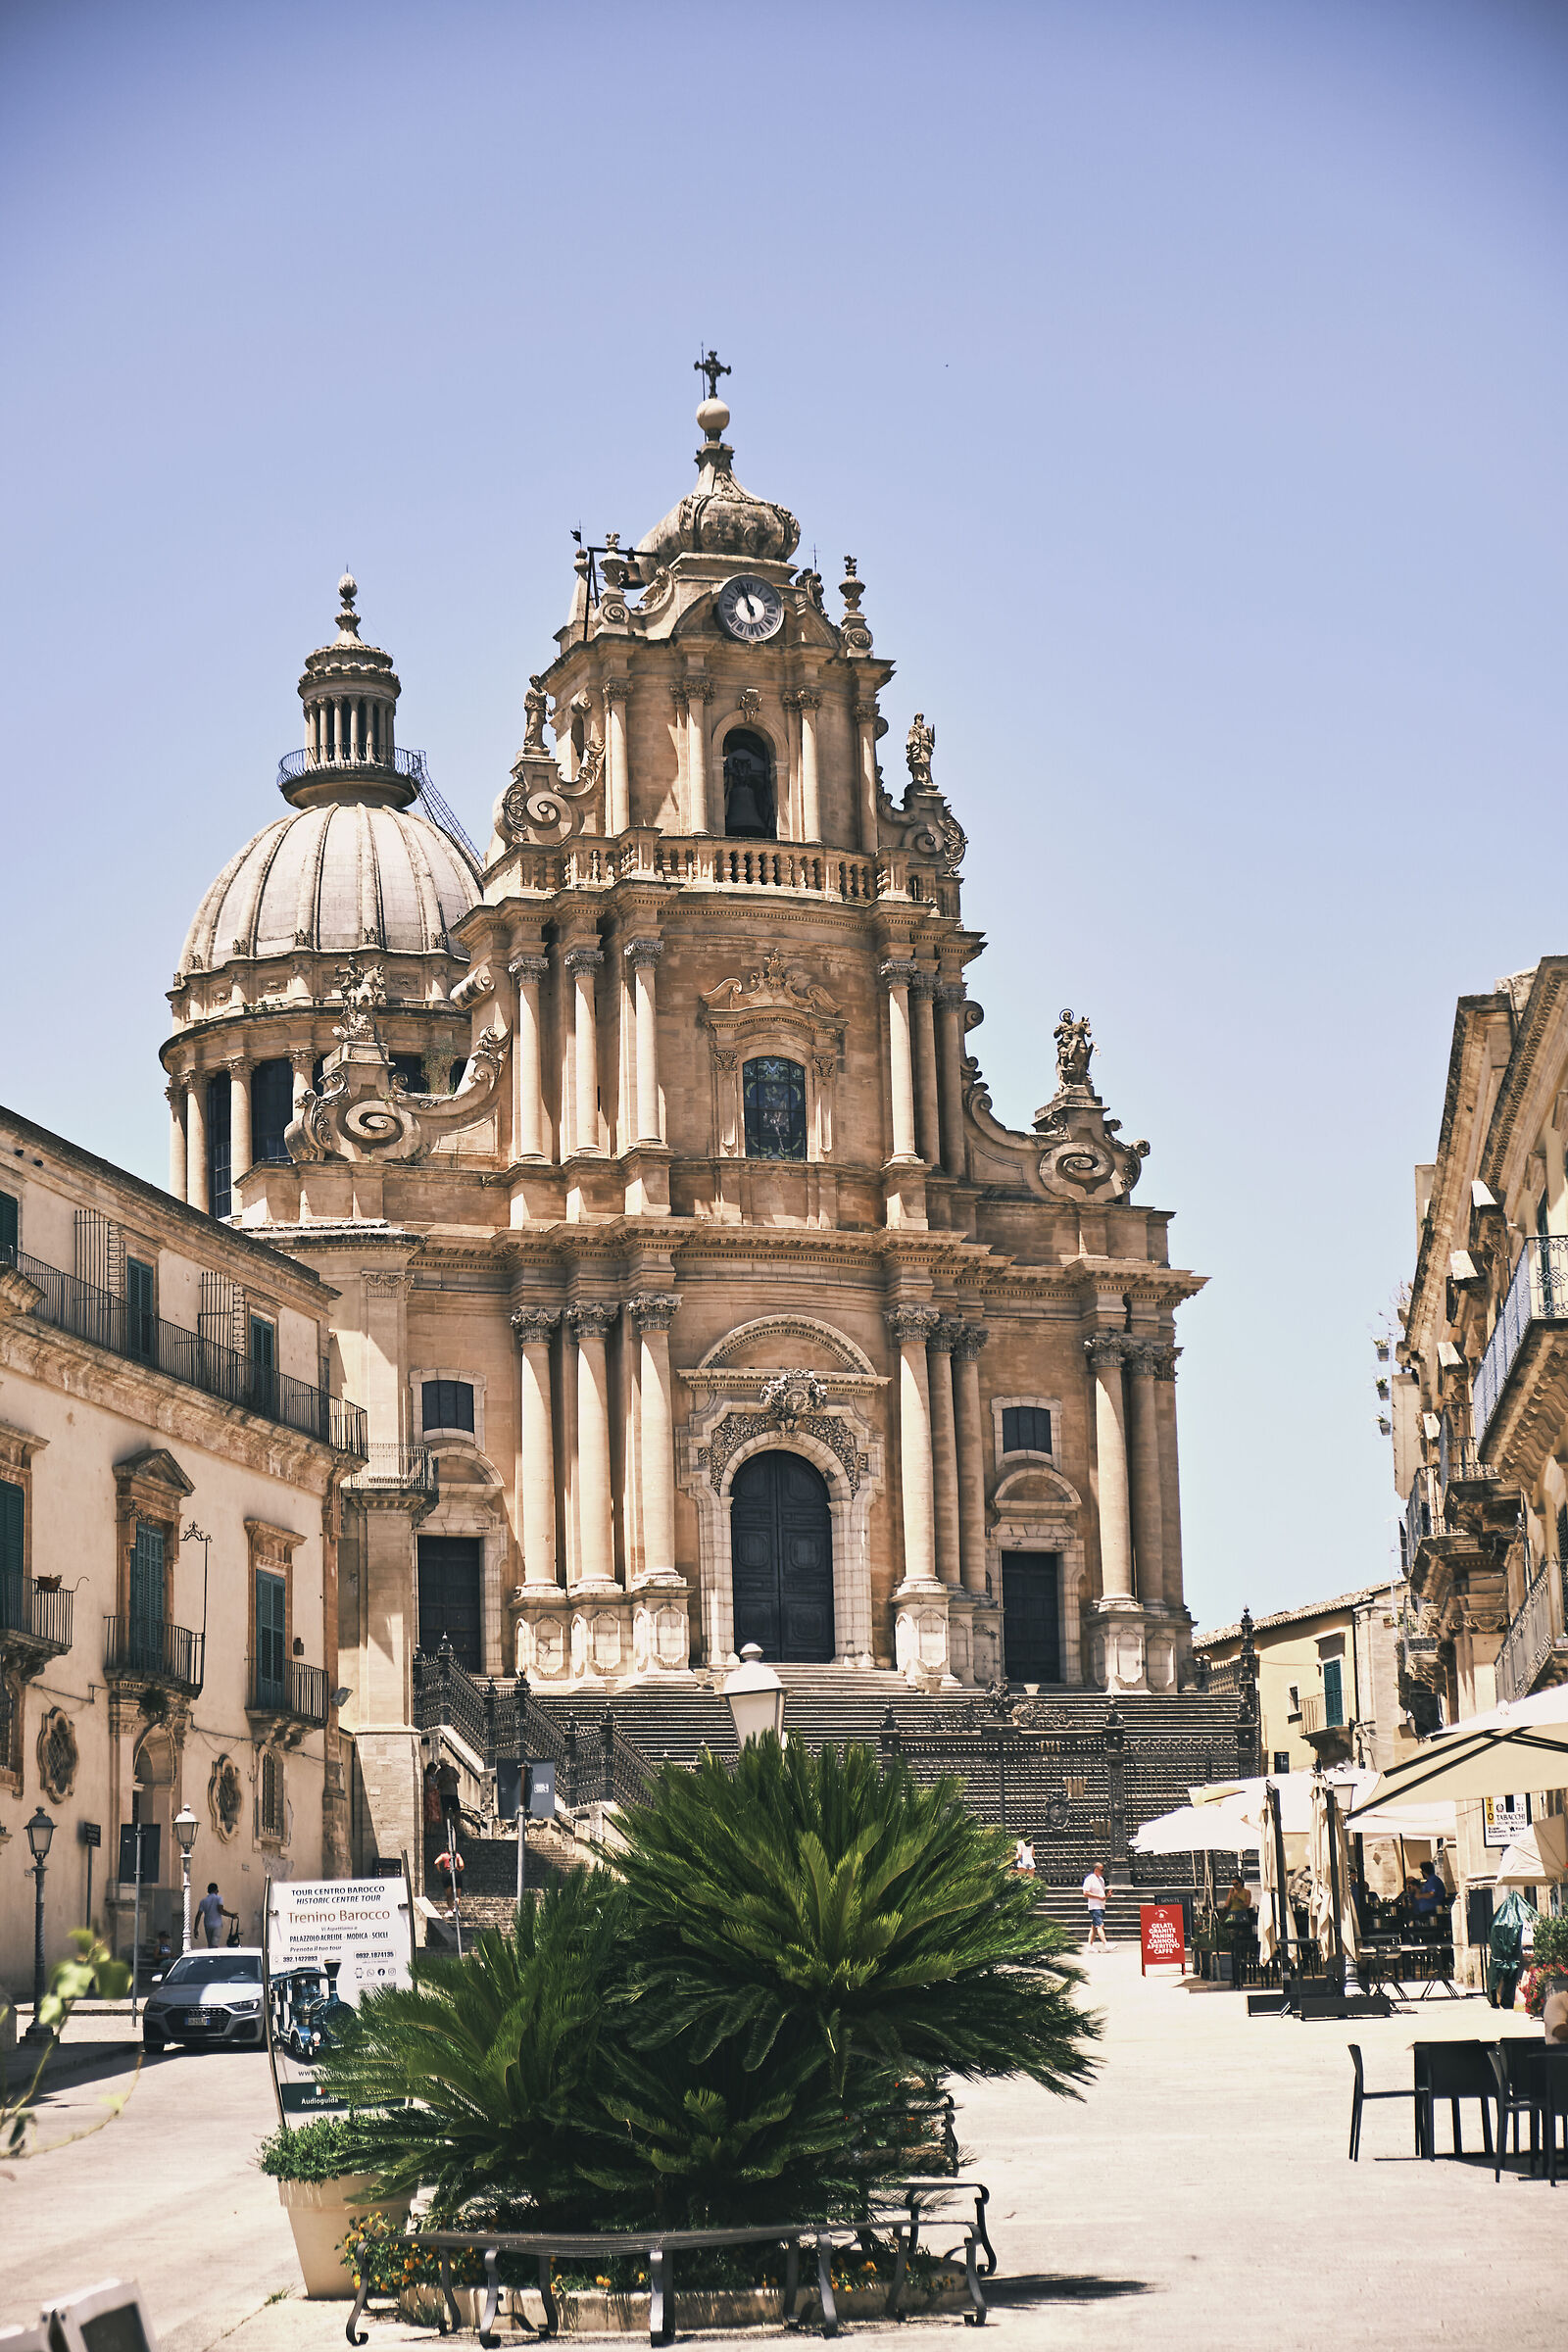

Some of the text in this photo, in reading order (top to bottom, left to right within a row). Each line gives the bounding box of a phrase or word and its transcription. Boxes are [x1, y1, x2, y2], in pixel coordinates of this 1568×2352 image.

[291, 1886, 385, 1897] TOUR CENTRO BAROCCO
[296, 1896, 331, 1905] HISTORIC
[331, 1895, 359, 1904] CENTRE
[287, 1910, 390, 1924] Trenino Barocco
[289, 1935, 320, 1943] PALAZZOLO
[346, 1932, 368, 1940] MODICA
[301, 2097, 339, 2106] Audioguida
